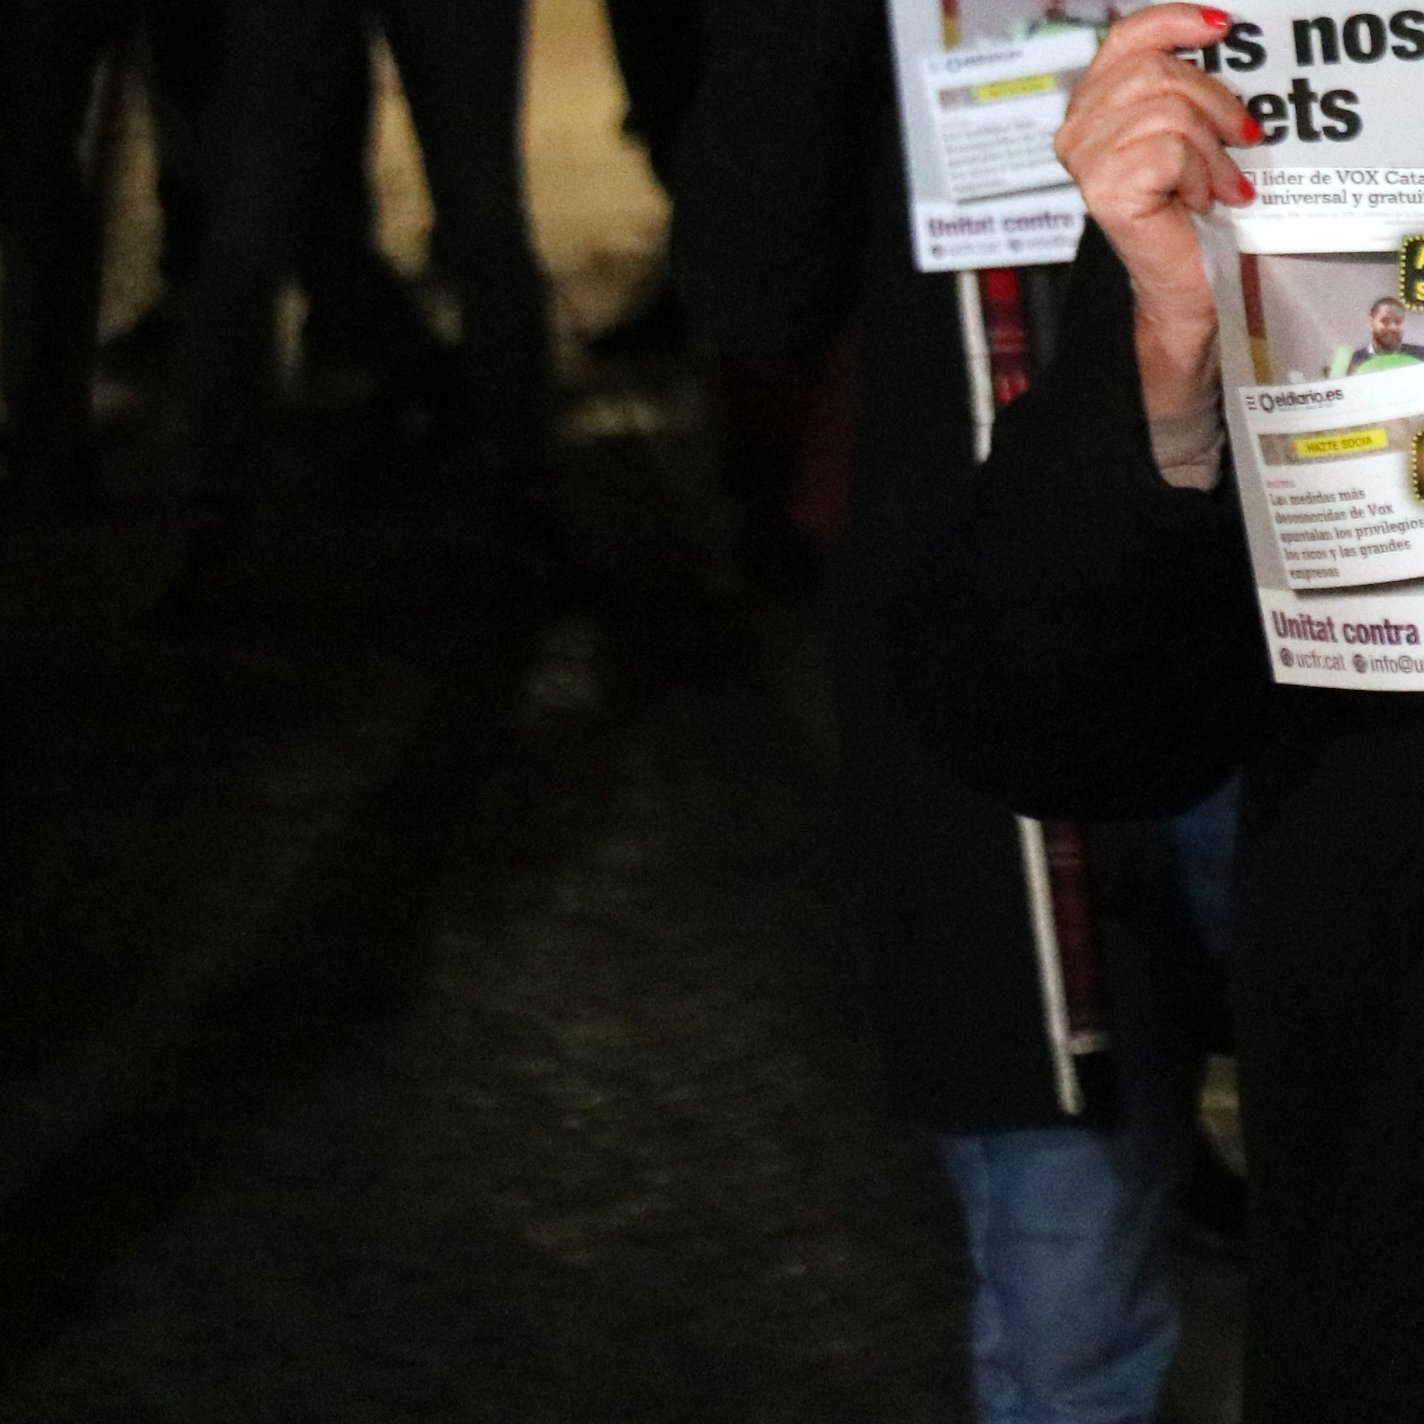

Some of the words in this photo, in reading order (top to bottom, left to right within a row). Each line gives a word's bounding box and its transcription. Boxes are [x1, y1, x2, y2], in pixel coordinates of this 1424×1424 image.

[1310, 170, 1332, 185] de
[1335, 170, 1379, 185] VOX
[1261, 189, 1348, 206] universal
[1352, 192, 1363, 208] y
[1275, 388, 1344, 408] eldiario.es
[1338, 488, 1366, 501] más
[1350, 506, 1365, 519] de
[1367, 503, 1395, 516] Vox
[1335, 525, 1354, 540] los
[1359, 538, 1412, 560] grandes
[1271, 610, 1338, 643] Unitat
[1343, 618, 1421, 646] contra
